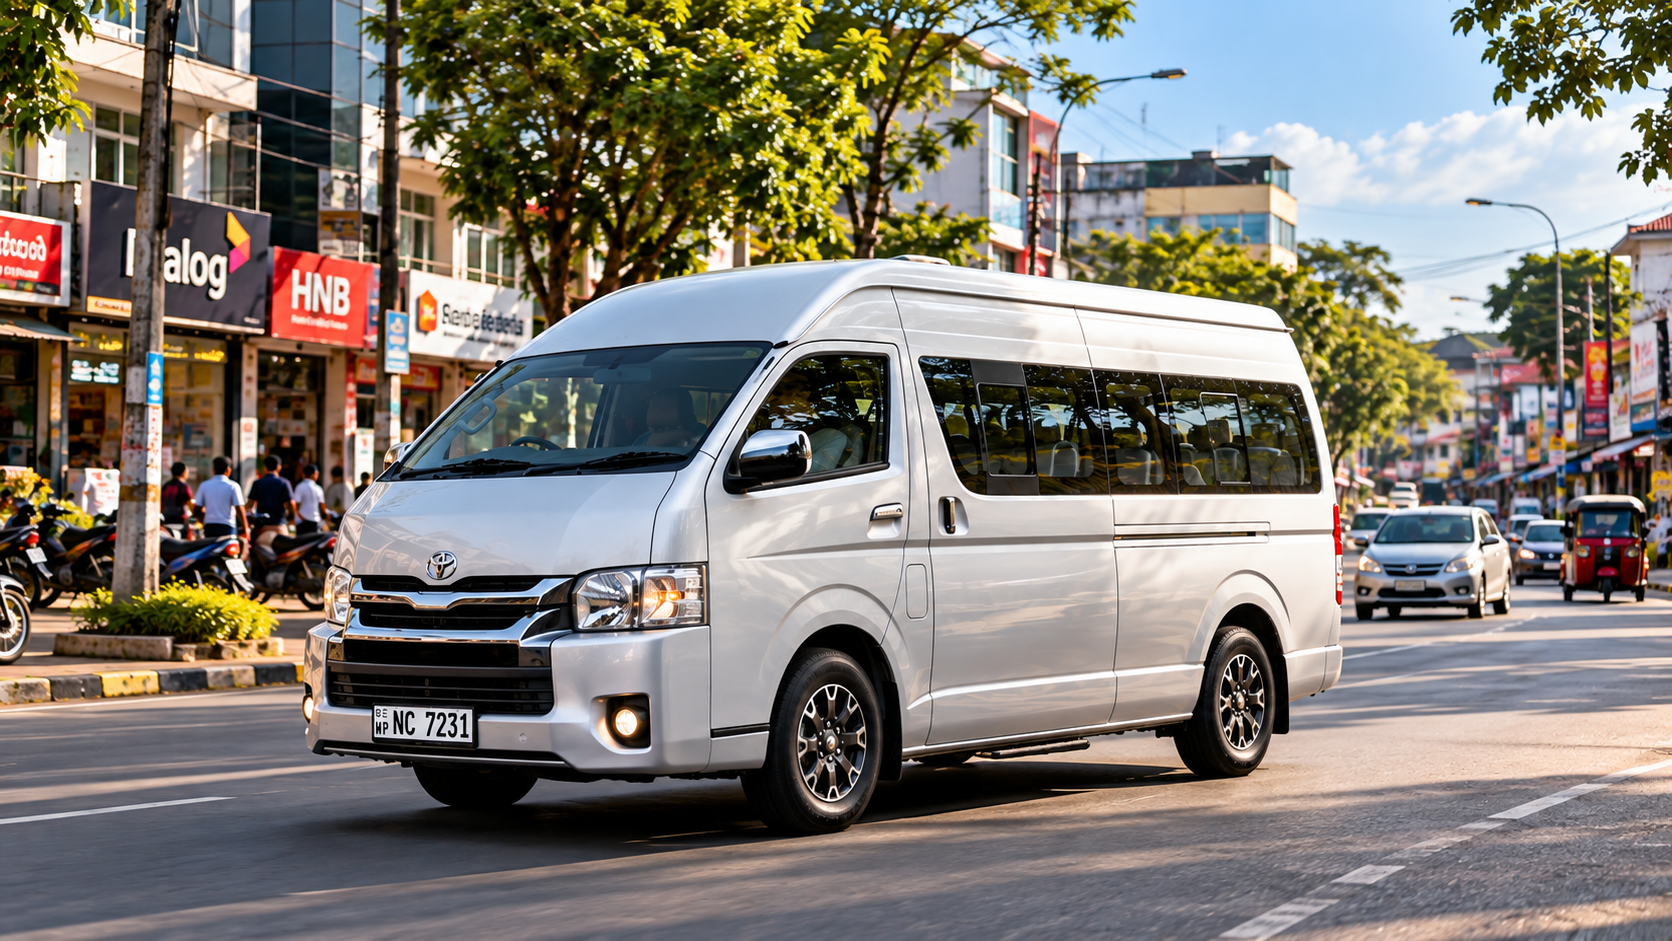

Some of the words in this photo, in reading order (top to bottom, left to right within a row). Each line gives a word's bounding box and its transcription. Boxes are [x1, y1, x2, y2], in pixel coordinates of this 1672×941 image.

[291, 268, 351, 317] HNB
[393, 710, 416, 736] NC
[425, 711, 469, 739] 7231
